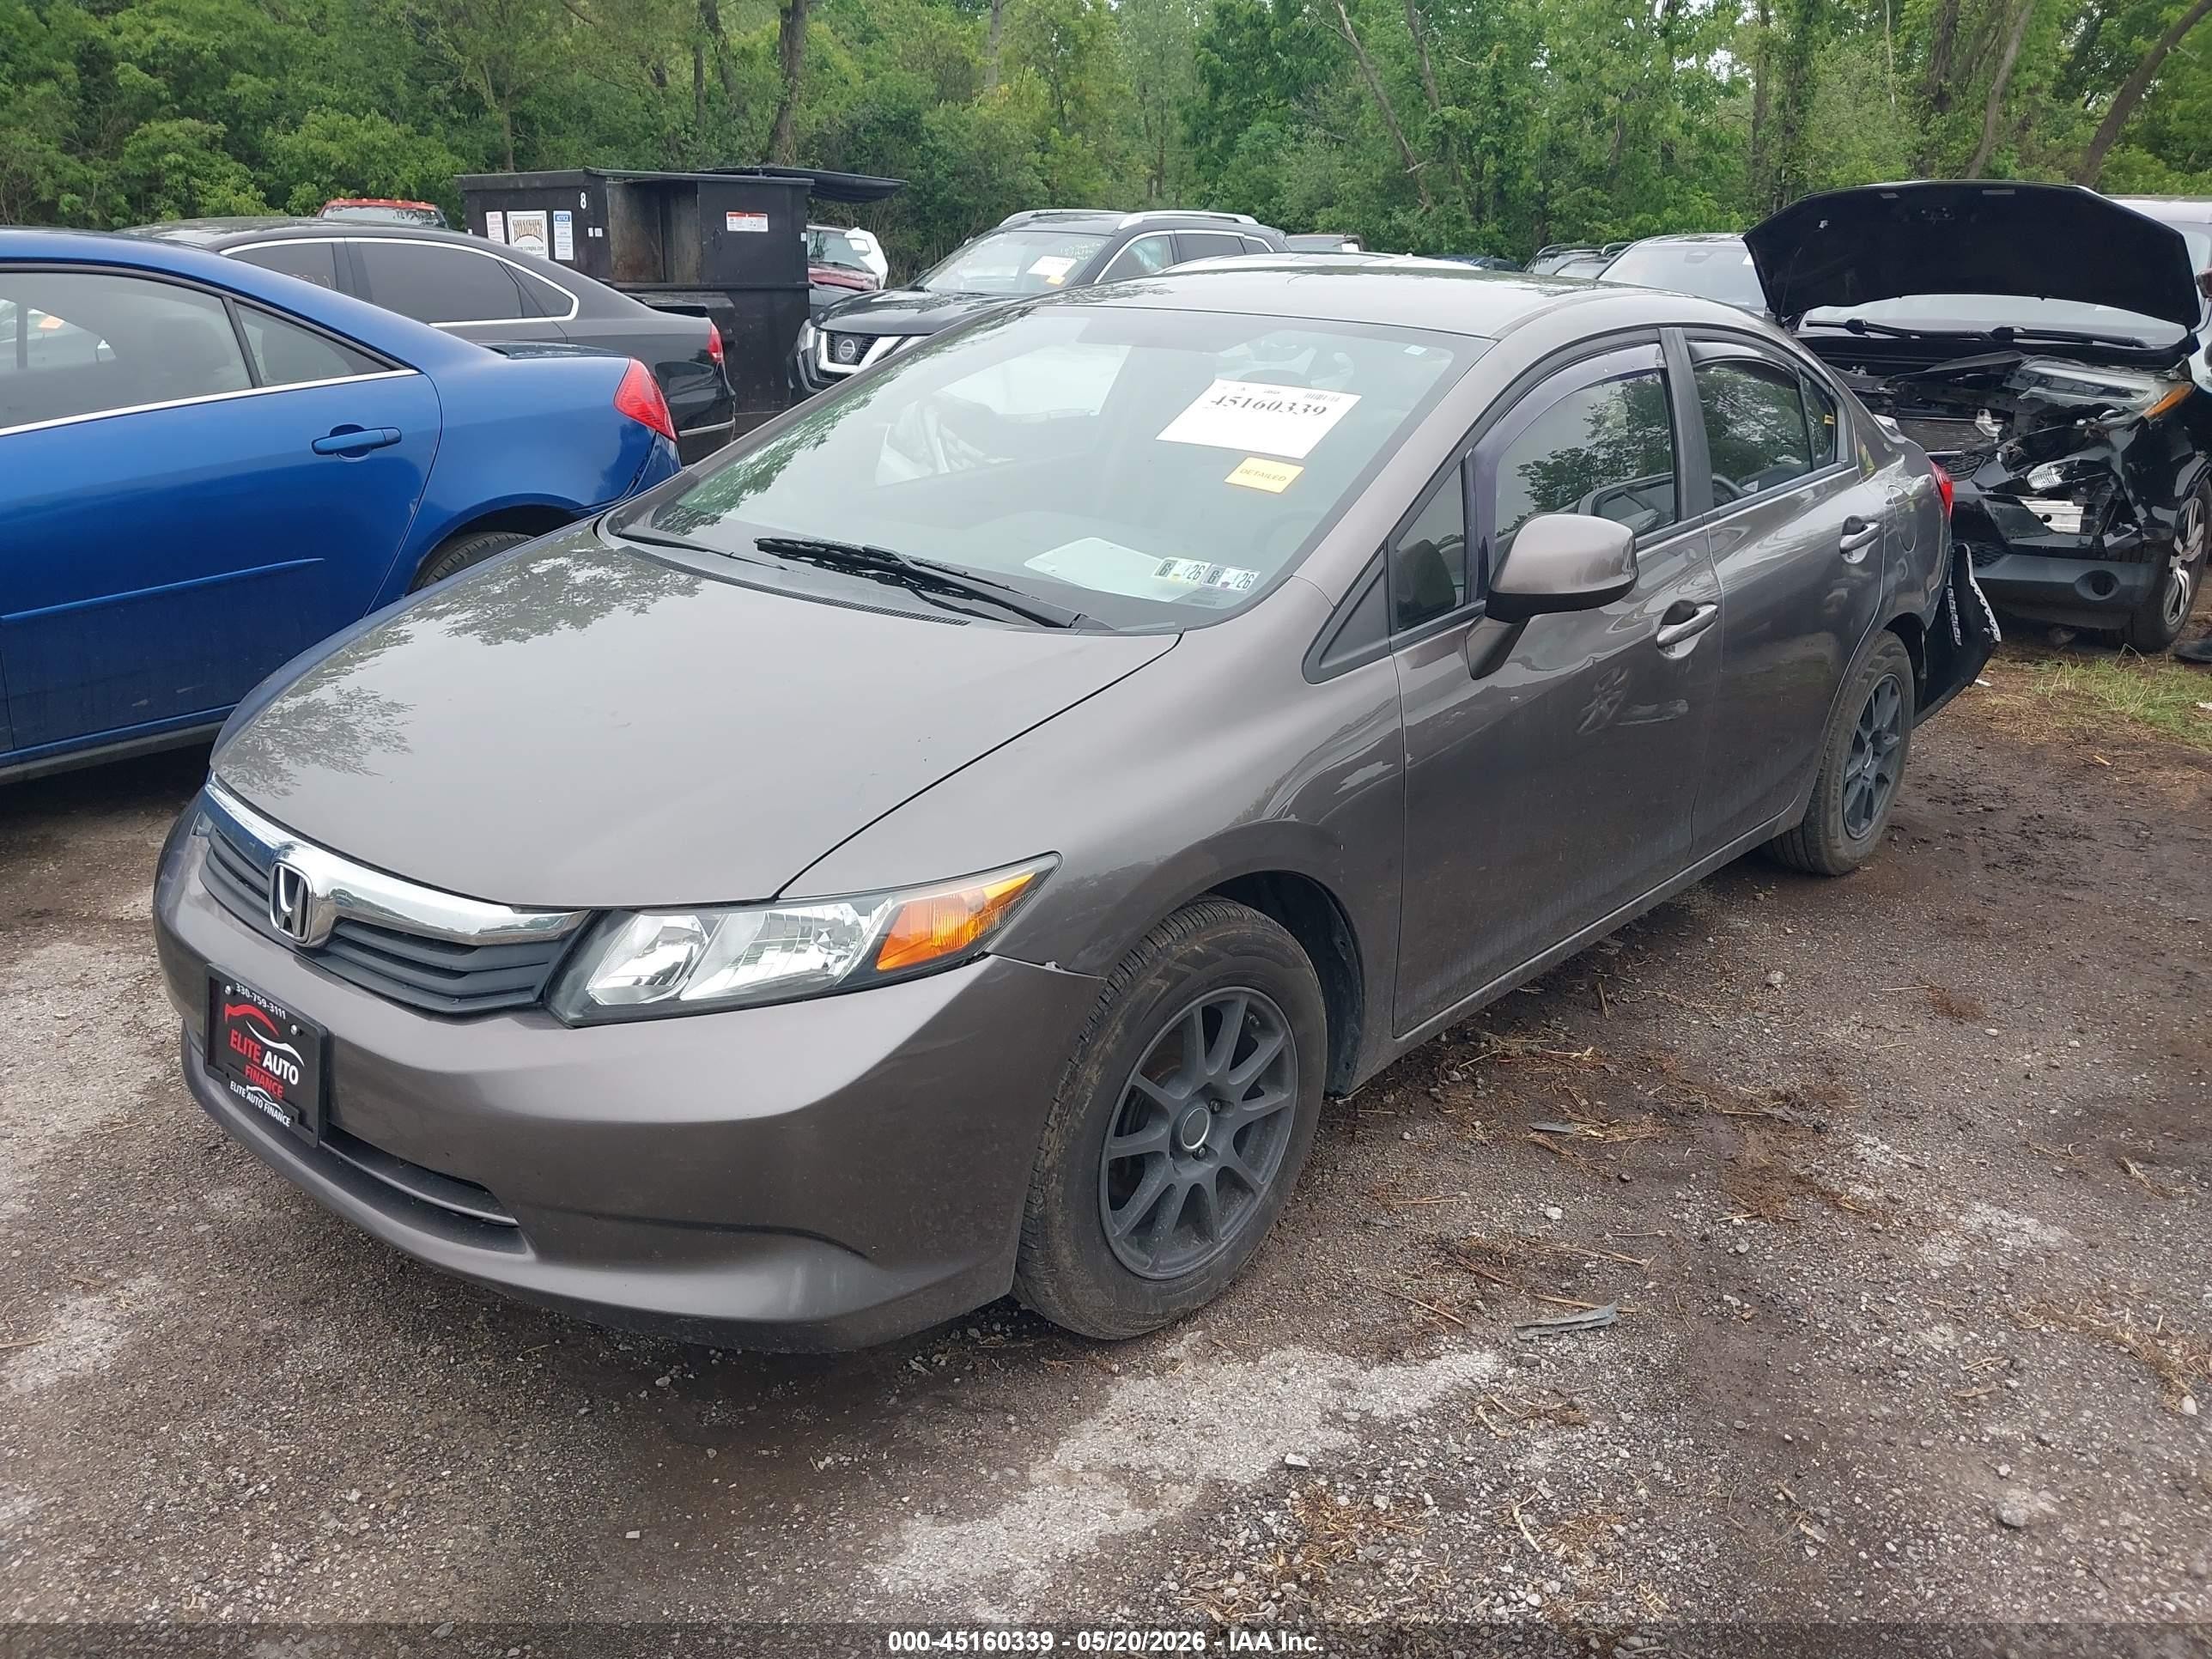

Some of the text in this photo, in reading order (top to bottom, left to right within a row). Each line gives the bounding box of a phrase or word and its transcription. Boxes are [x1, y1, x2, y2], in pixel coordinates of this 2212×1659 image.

[580, 191, 586, 209] 8
[1209, 394, 1328, 416] 45160339
[1239, 468, 1286, 483] DETAILED
[1187, 564, 1206, 580] 26
[1237, 573, 1255, 589] 26
[235, 982, 287, 1020] 330-759-3111
[229, 1029, 299, 1085] ELITE AUTO
[245, 1064, 284, 1098] FINANCE
[229, 1080, 291, 1127] ELITE AUTO FINANCE
